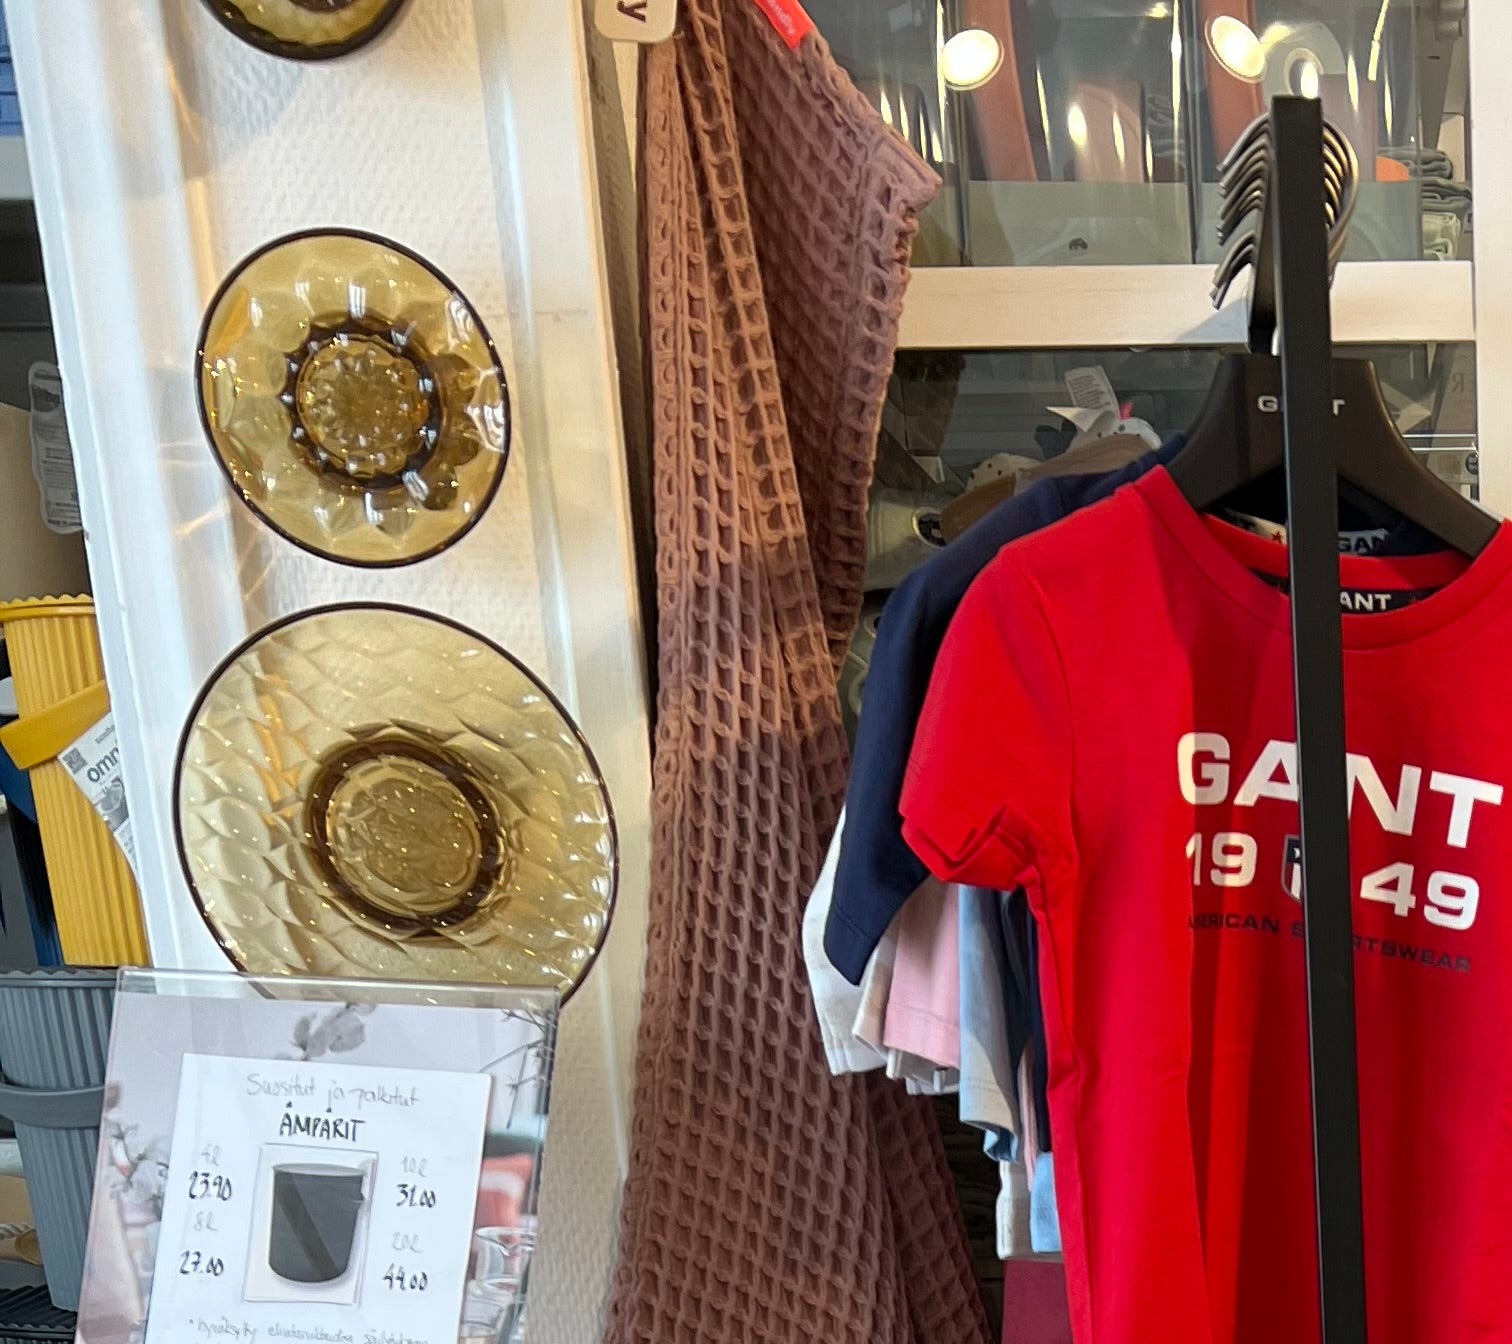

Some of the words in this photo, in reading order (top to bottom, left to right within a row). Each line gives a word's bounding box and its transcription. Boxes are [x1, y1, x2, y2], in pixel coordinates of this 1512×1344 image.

[1257, 395, 1346, 416] GT
[1339, 591, 1392, 612] ANT
[1176, 731, 1504, 848] GANT
[1185, 831, 1258, 888] 19
[1359, 861, 1480, 931] 49
